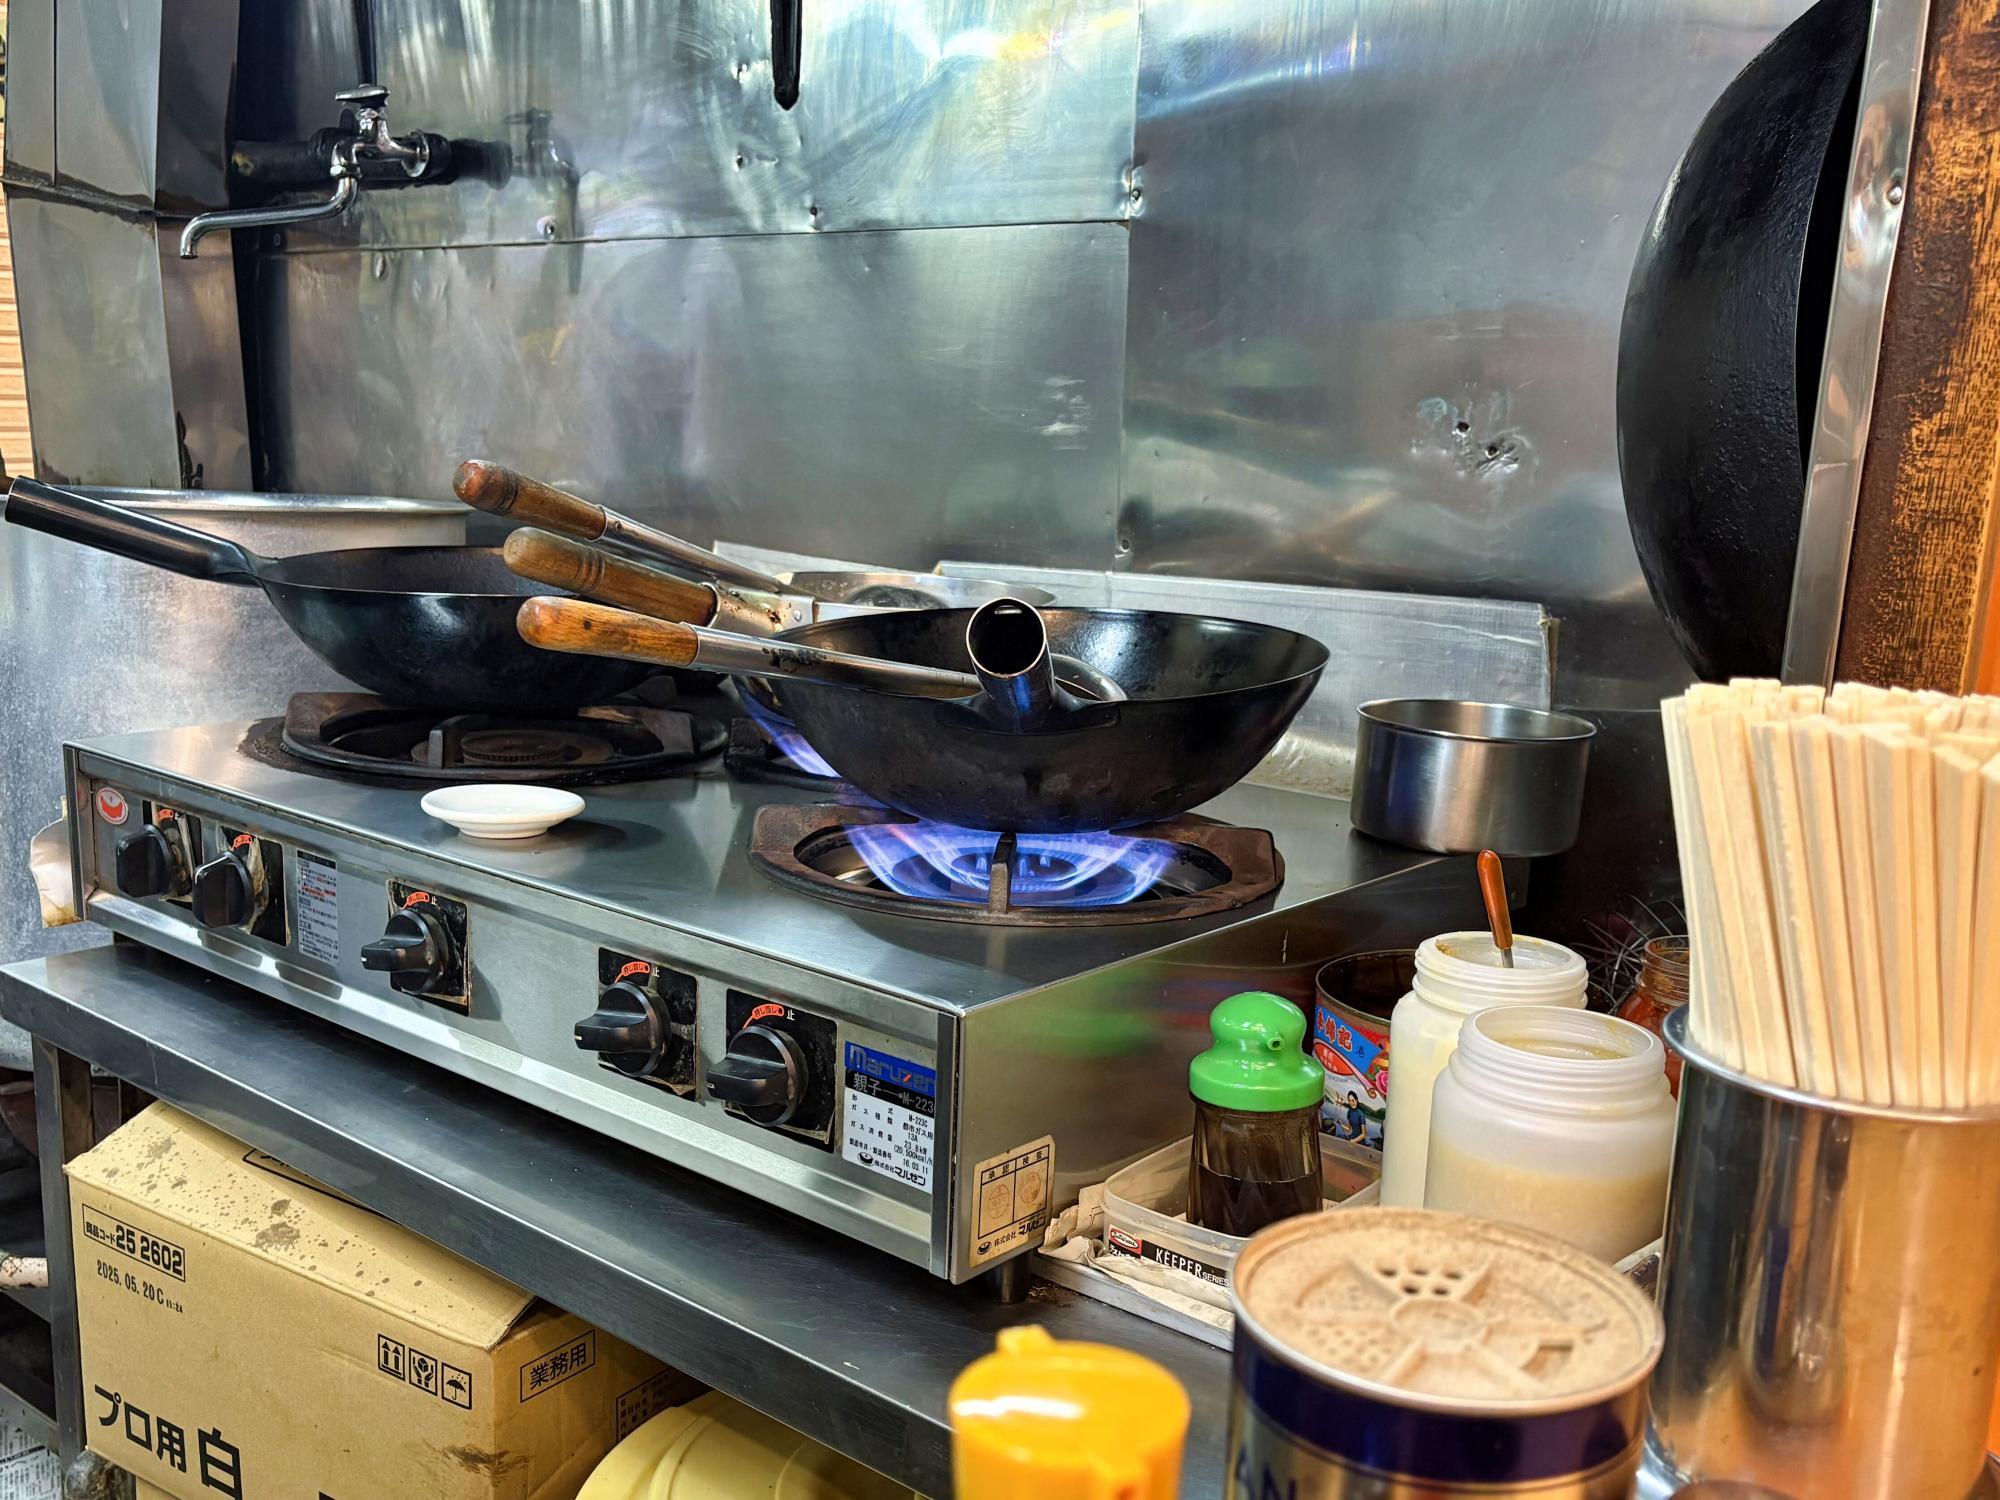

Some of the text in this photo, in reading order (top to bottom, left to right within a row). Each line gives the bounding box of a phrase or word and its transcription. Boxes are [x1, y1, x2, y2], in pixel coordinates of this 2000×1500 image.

[431, 896, 438, 906] 止
[652, 967, 660, 977] 止
[787, 1009, 796, 1021] 止
[853, 1072, 936, 1115] 親子 M-223
[908, 1132, 919, 1143] 13A
[140, 1235, 183, 1277] 2602
[1156, 1248, 1202, 1280] KEEPER
[1202, 1271, 1230, 1288] SERIES
[530, 1342, 587, 1390] 業務用
